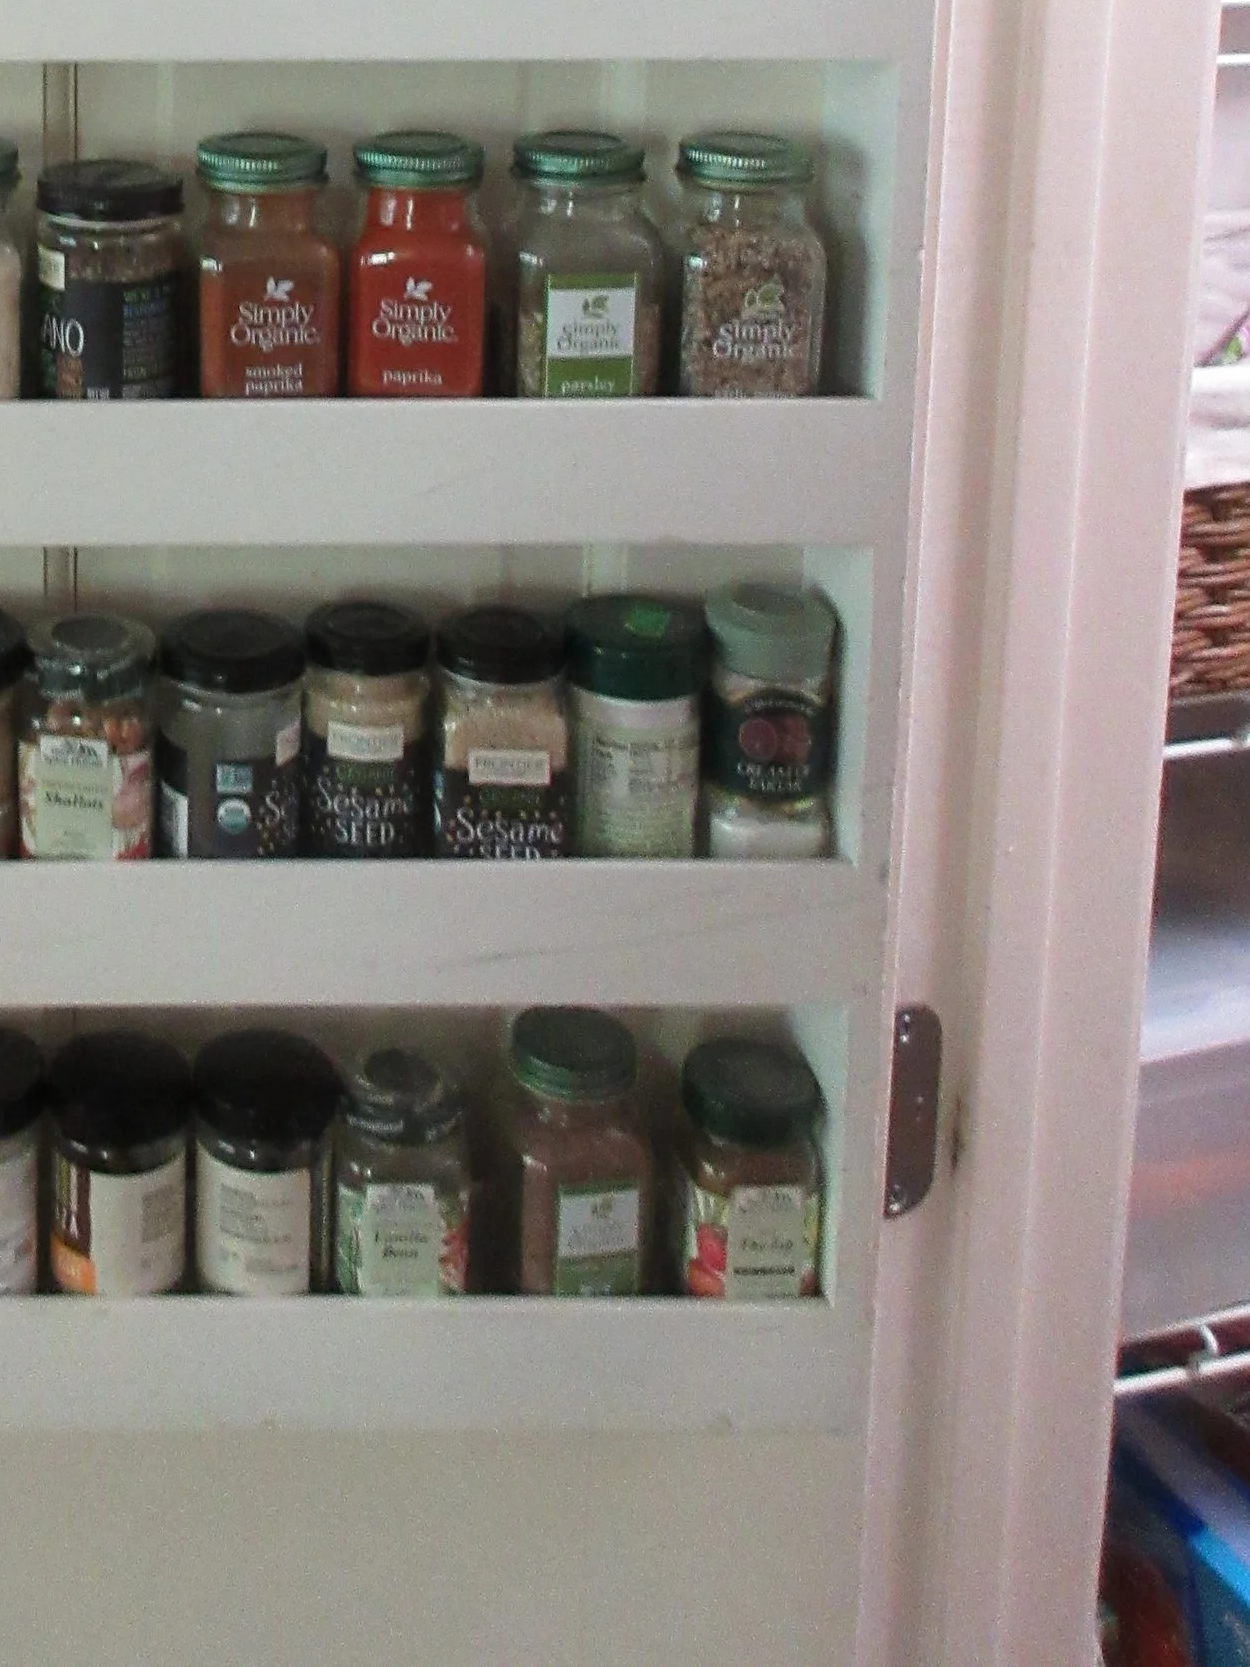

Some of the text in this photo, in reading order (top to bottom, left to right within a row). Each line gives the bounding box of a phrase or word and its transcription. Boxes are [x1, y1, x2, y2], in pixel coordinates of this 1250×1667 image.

[238, 301, 314, 328] Simply
[380, 298, 452, 326] Simply
[230, 322, 319, 352] Organic
[371, 318, 456, 346] Organic
[719, 318, 794, 344] Simply
[245, 362, 303, 379] smoked
[382, 368, 443, 387] paprika
[245, 378, 303, 397] paprika
